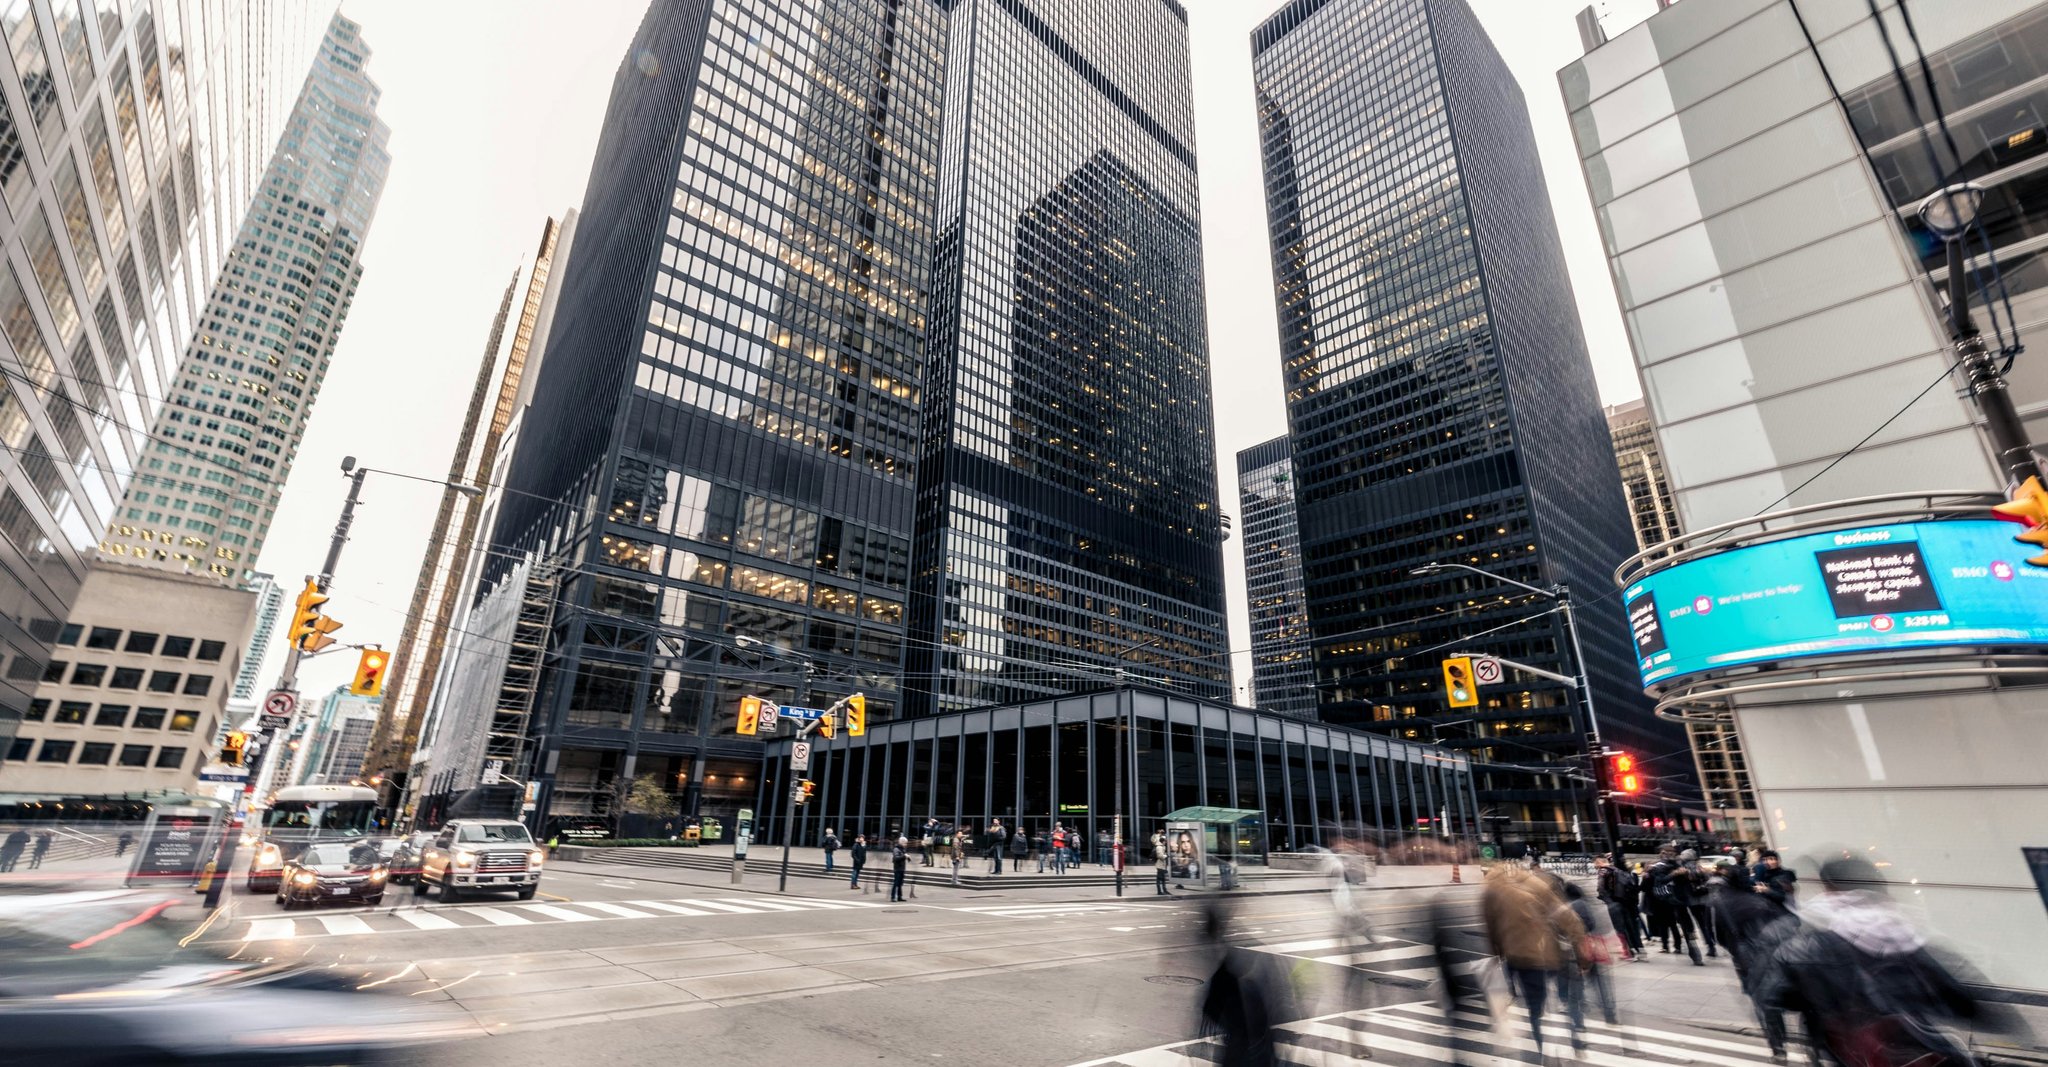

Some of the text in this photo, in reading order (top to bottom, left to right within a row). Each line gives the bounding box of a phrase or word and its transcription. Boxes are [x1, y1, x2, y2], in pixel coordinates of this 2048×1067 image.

[1834, 530, 1890, 545] Business
[1825, 552, 1916, 573] National Bank of
[1837, 565, 1914, 583] Canada wants
[1952, 566, 1988, 578] BMO
[1883, 574, 1922, 589] capital
[789, 708, 804, 718] King
